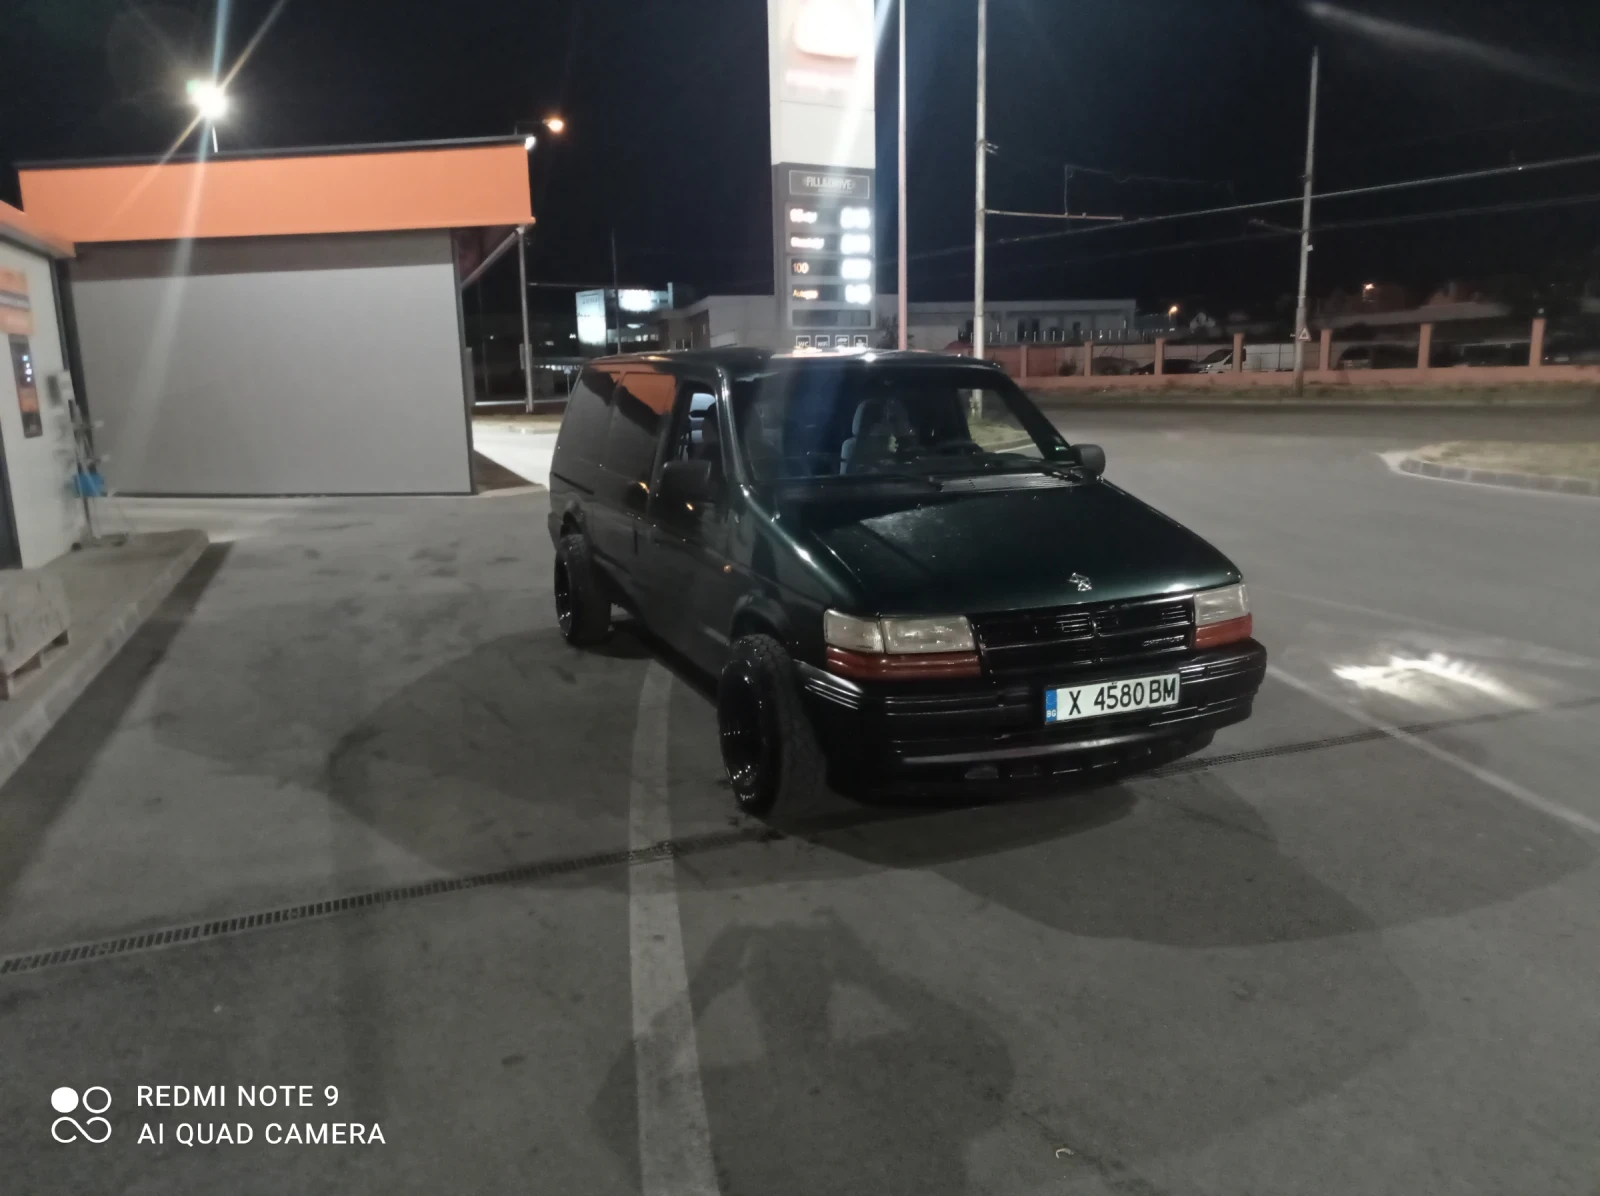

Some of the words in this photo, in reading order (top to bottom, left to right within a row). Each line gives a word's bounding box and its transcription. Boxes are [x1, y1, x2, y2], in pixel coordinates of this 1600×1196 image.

[1068, 690, 1082, 716] X
[1094, 682, 1145, 711] 4580
[1149, 677, 1177, 704] BM
[1046, 710, 1057, 718] BG
